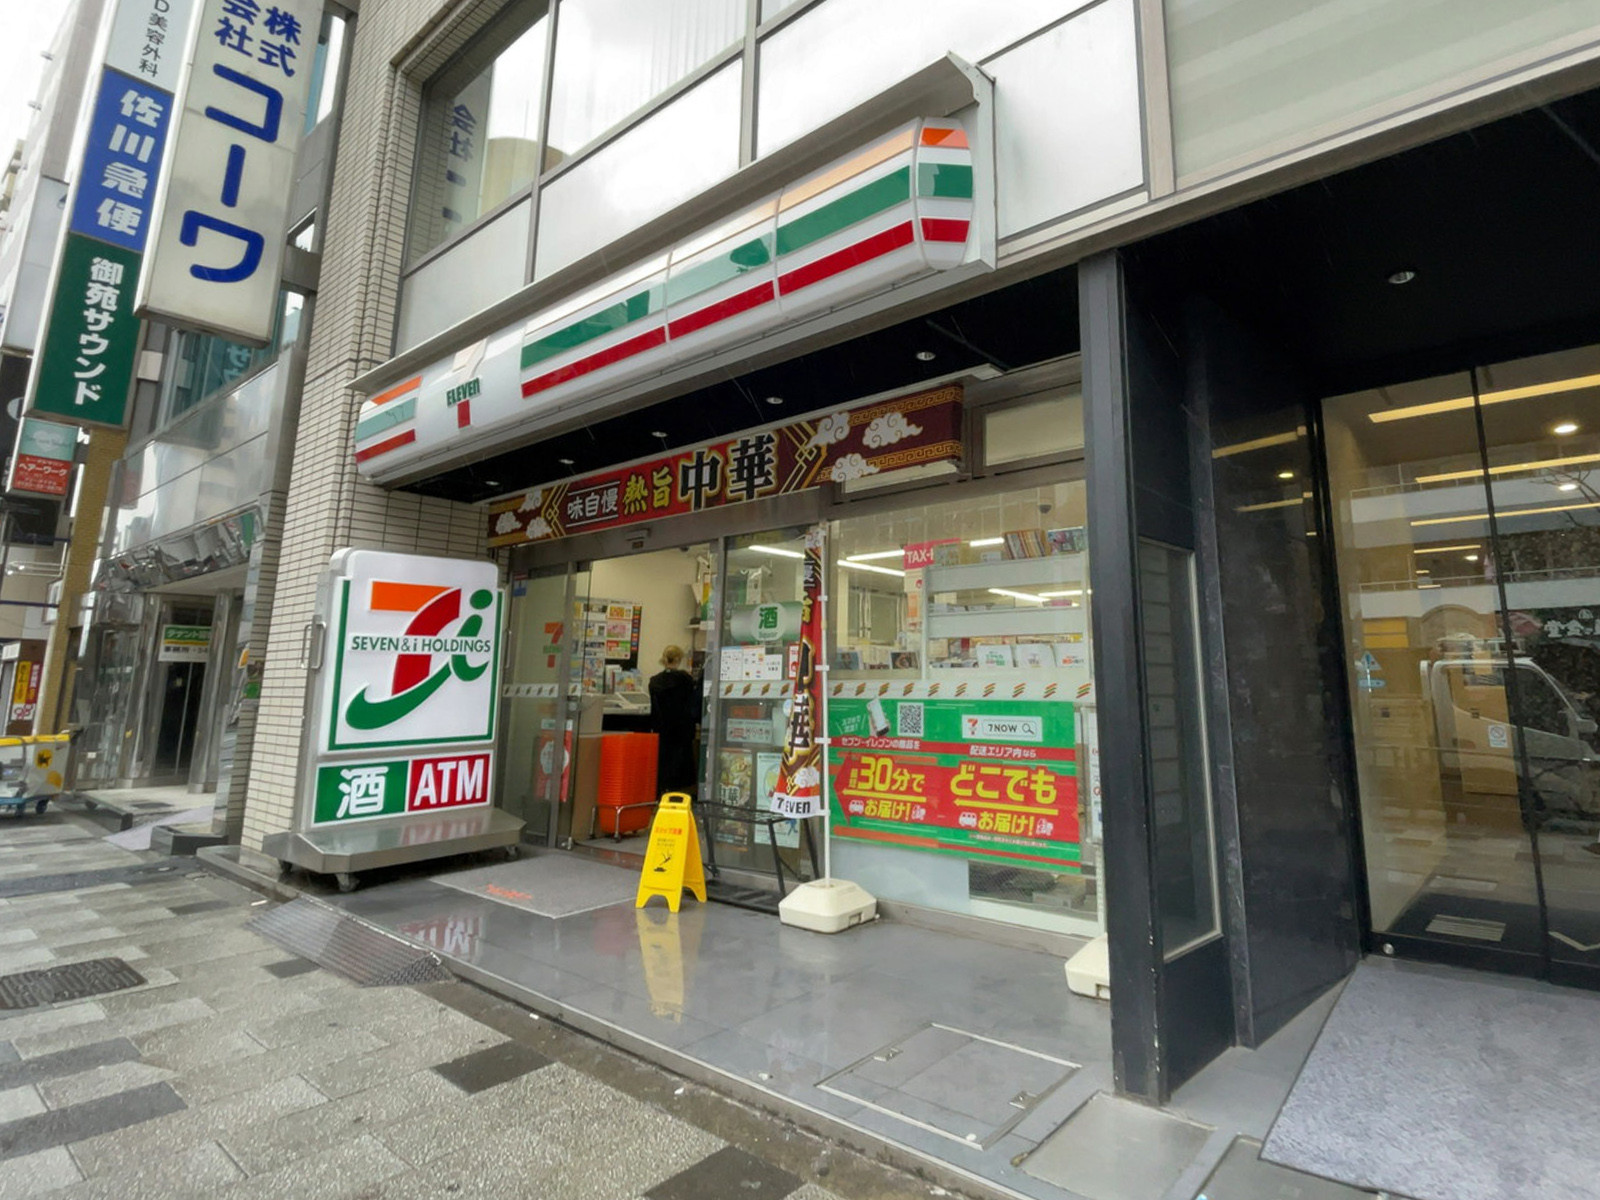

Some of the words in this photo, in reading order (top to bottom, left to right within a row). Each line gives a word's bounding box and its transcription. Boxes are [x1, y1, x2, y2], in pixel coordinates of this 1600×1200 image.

[96, 89, 164, 237] 佐川急便
[179, 63, 284, 283] コーワ
[73, 256, 124, 406] 御苑サウンド
[567, 487, 618, 520] 味自慢
[623, 465, 674, 515] 熱旨
[680, 434, 776, 510] 中華
[759, 606, 778, 630] 酒
[421, 637, 492, 654] HOLDINGS
[988, 723, 1018, 733] 7NOW
[336, 765, 390, 819] 酒
[413, 759, 486, 807] ATM
[950, 763, 1058, 805] どこでも
